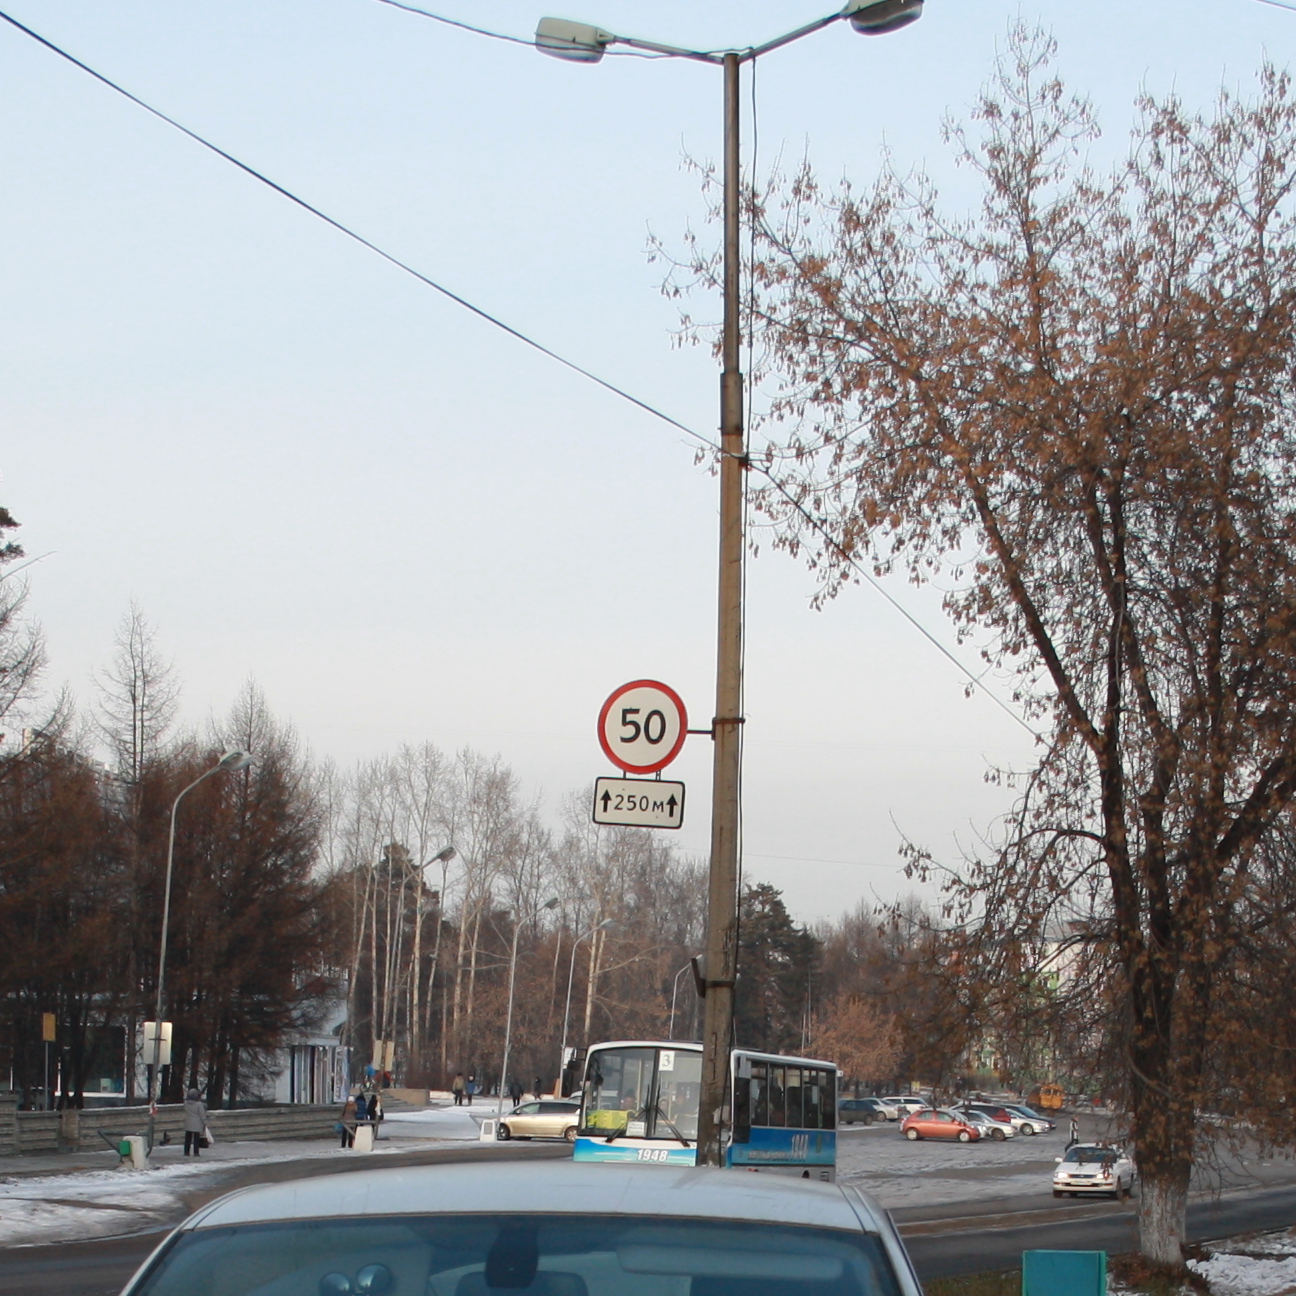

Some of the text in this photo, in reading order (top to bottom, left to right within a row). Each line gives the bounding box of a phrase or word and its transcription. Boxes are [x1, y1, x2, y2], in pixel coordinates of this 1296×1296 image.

[620, 708, 666, 745] 50
[661, 1053, 671, 1067] 3
[637, 1149, 668, 1162] 1948
